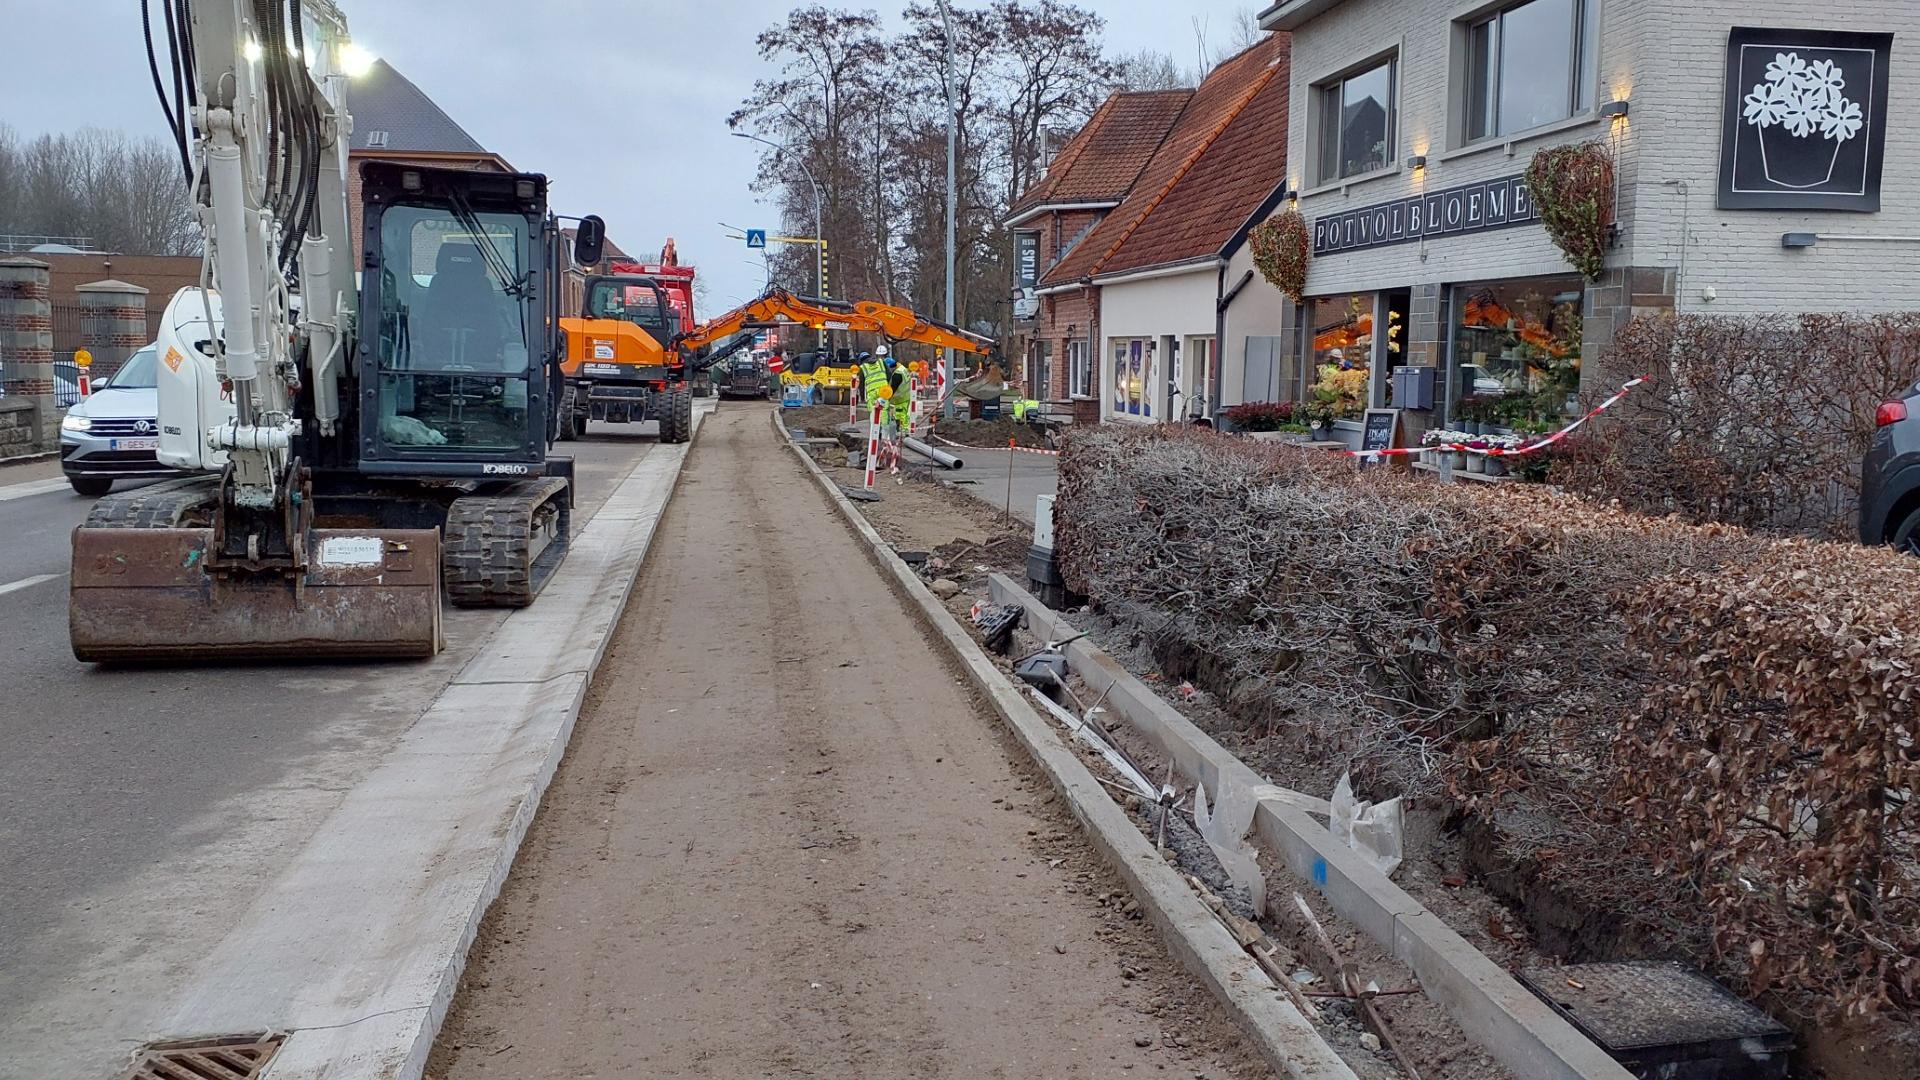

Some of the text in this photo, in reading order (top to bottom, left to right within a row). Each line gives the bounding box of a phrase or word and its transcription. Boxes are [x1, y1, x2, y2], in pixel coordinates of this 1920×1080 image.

[1316, 184, 1530, 247] POTVOLBLOEME
[1022, 249, 1036, 280] ATLAS
[483, 464, 528, 474] KOBELCO
